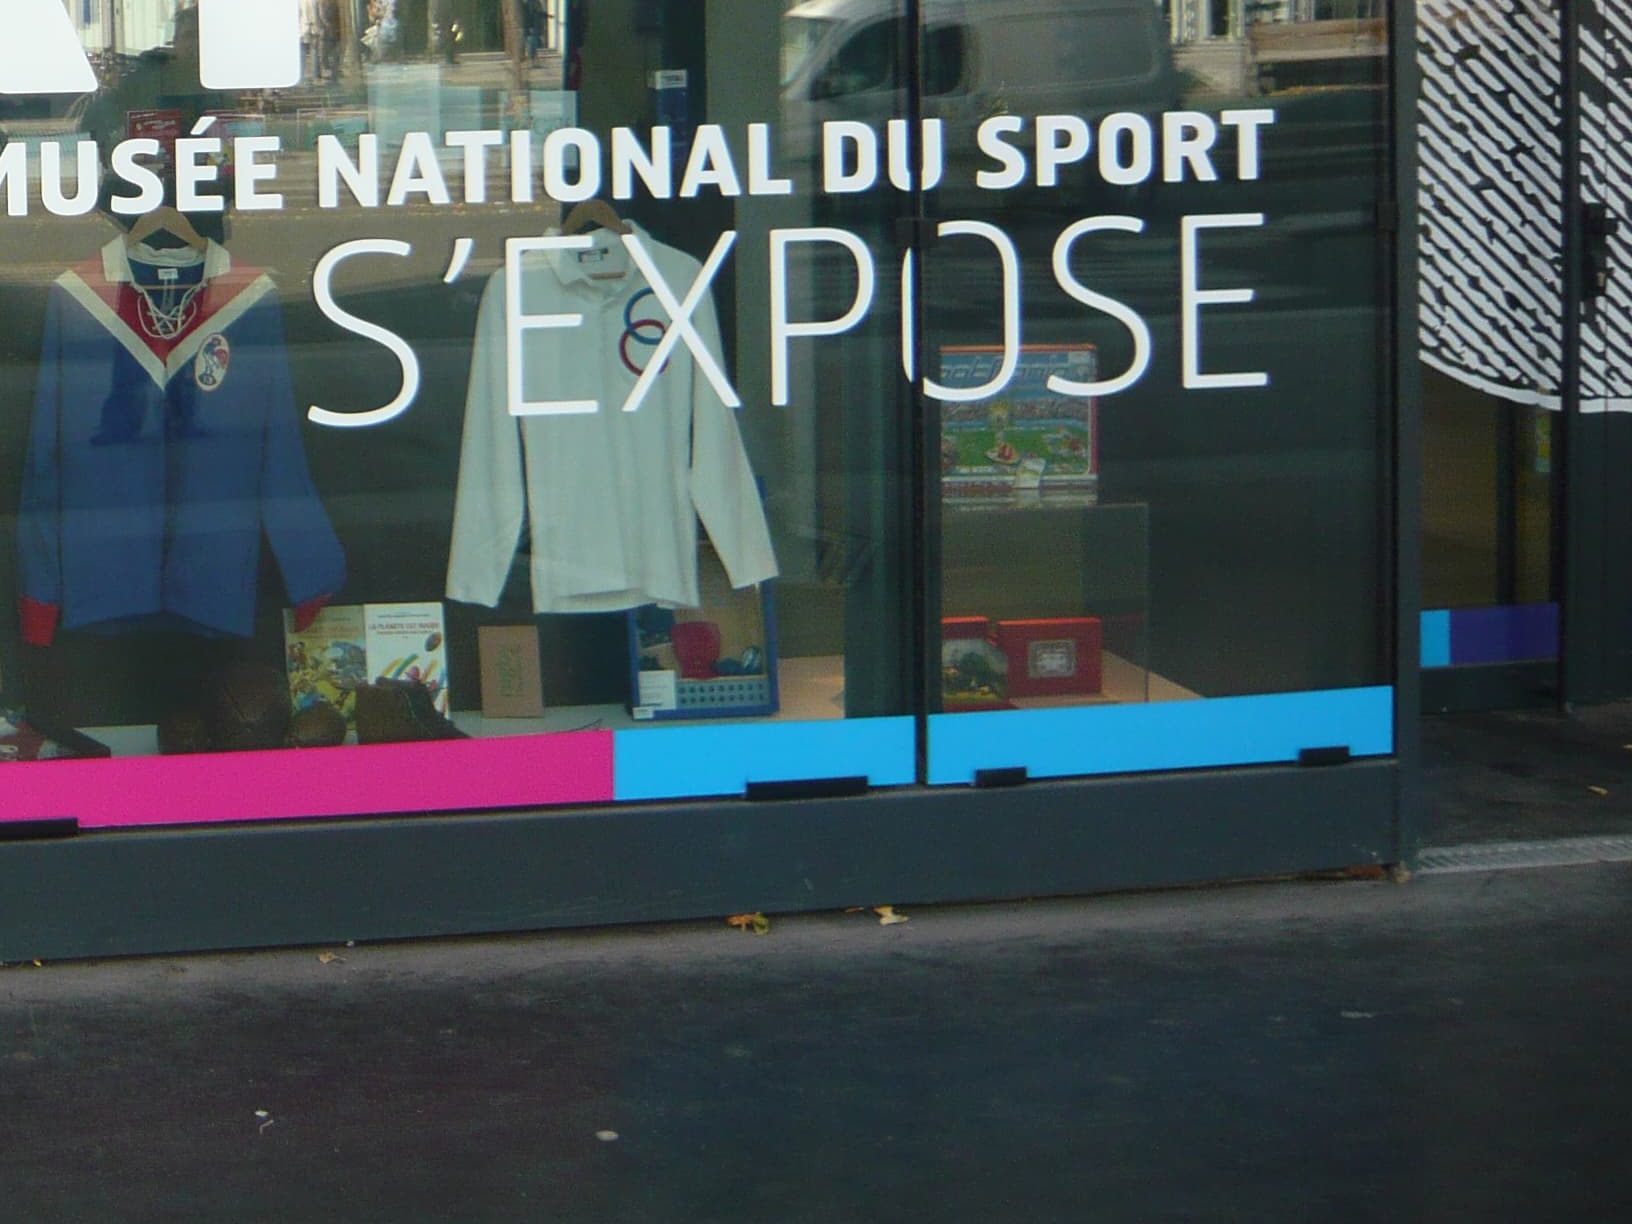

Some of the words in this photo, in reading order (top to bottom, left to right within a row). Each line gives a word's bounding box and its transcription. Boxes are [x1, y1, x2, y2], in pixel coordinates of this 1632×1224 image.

[318, 123, 791, 208] NATIONAL
[824, 118, 941, 193] DU
[977, 109, 1274, 189] SPORT
[308, 213, 1266, 426] S'EXPOSE
